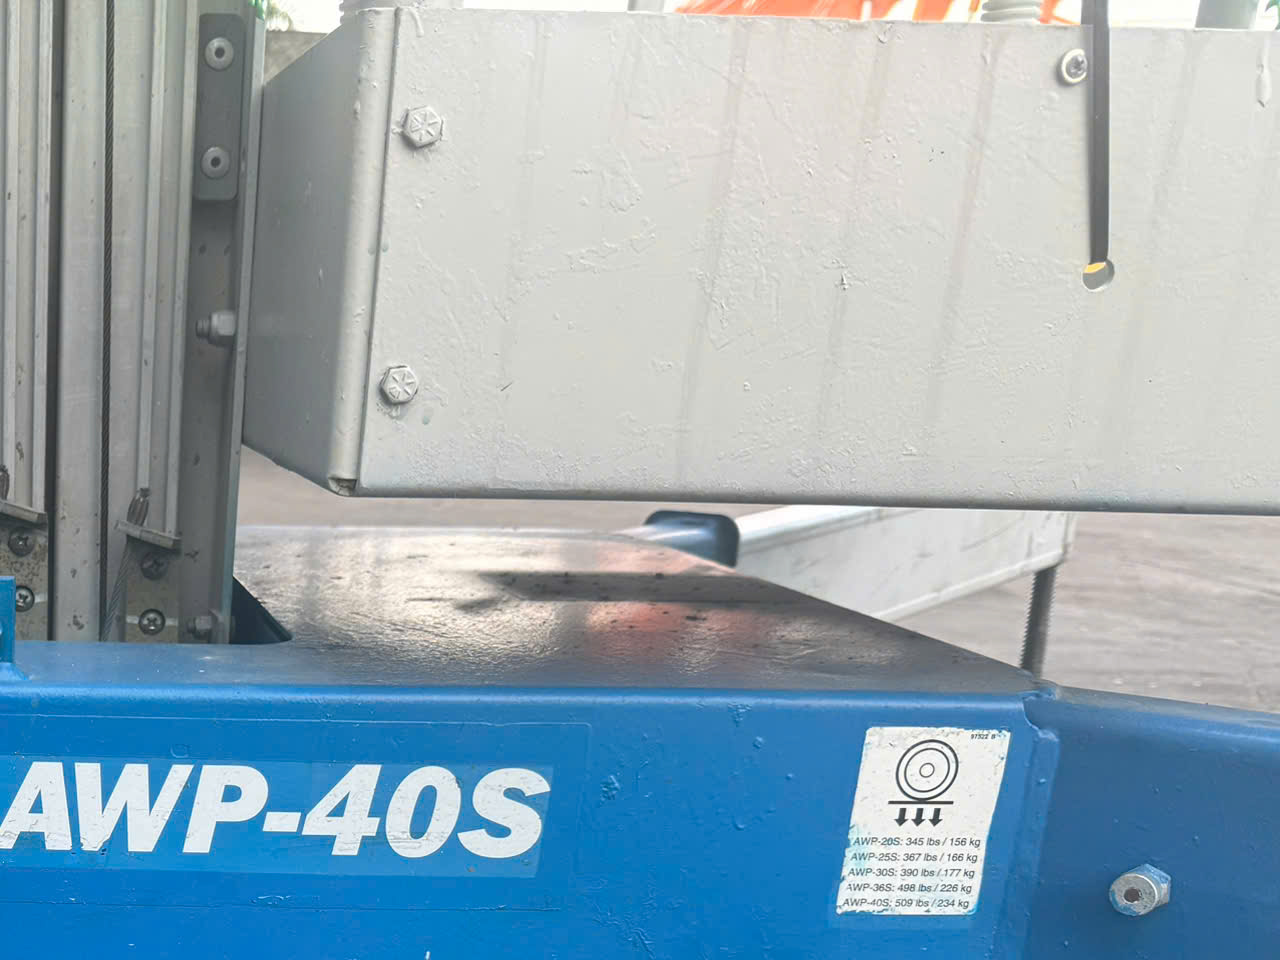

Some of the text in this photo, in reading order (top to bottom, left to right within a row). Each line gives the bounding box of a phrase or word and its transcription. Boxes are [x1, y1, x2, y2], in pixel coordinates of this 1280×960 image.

[852, 837, 903, 846] AWP-20S:
[905, 837, 924, 846] 345
[926, 837, 941, 846] lbs
[949, 837, 967, 846] 156
[969, 837, 981, 848] kg
[850, 852, 900, 862] AWP-25S:
[902, 852, 921, 862] 367
[923, 852, 938, 862] lbs
[946, 852, 964, 862] 166
[966, 853, 978, 864] kg
[847, 868, 898, 877] AWP-30S:
[899, 868, 919, 877] 390
[920, 868, 935, 877] lbs
[943, 868, 962, 877] 177
[963, 868, 975, 879] kg
[846, 883, 895, 893] AWP-36S:
[897, 883, 916, 893] 498
[918, 883, 933, 893] lbs
[939, 883, 959, 893] 226
[960, 884, 972, 894] kg
[842, 898, 892, 908] AWP-40S:
[894, 898, 913, 908] 509
[915, 898, 930, 908] lbs
[937, 898, 955, 908] 234
[957, 899, 970, 909] kg
